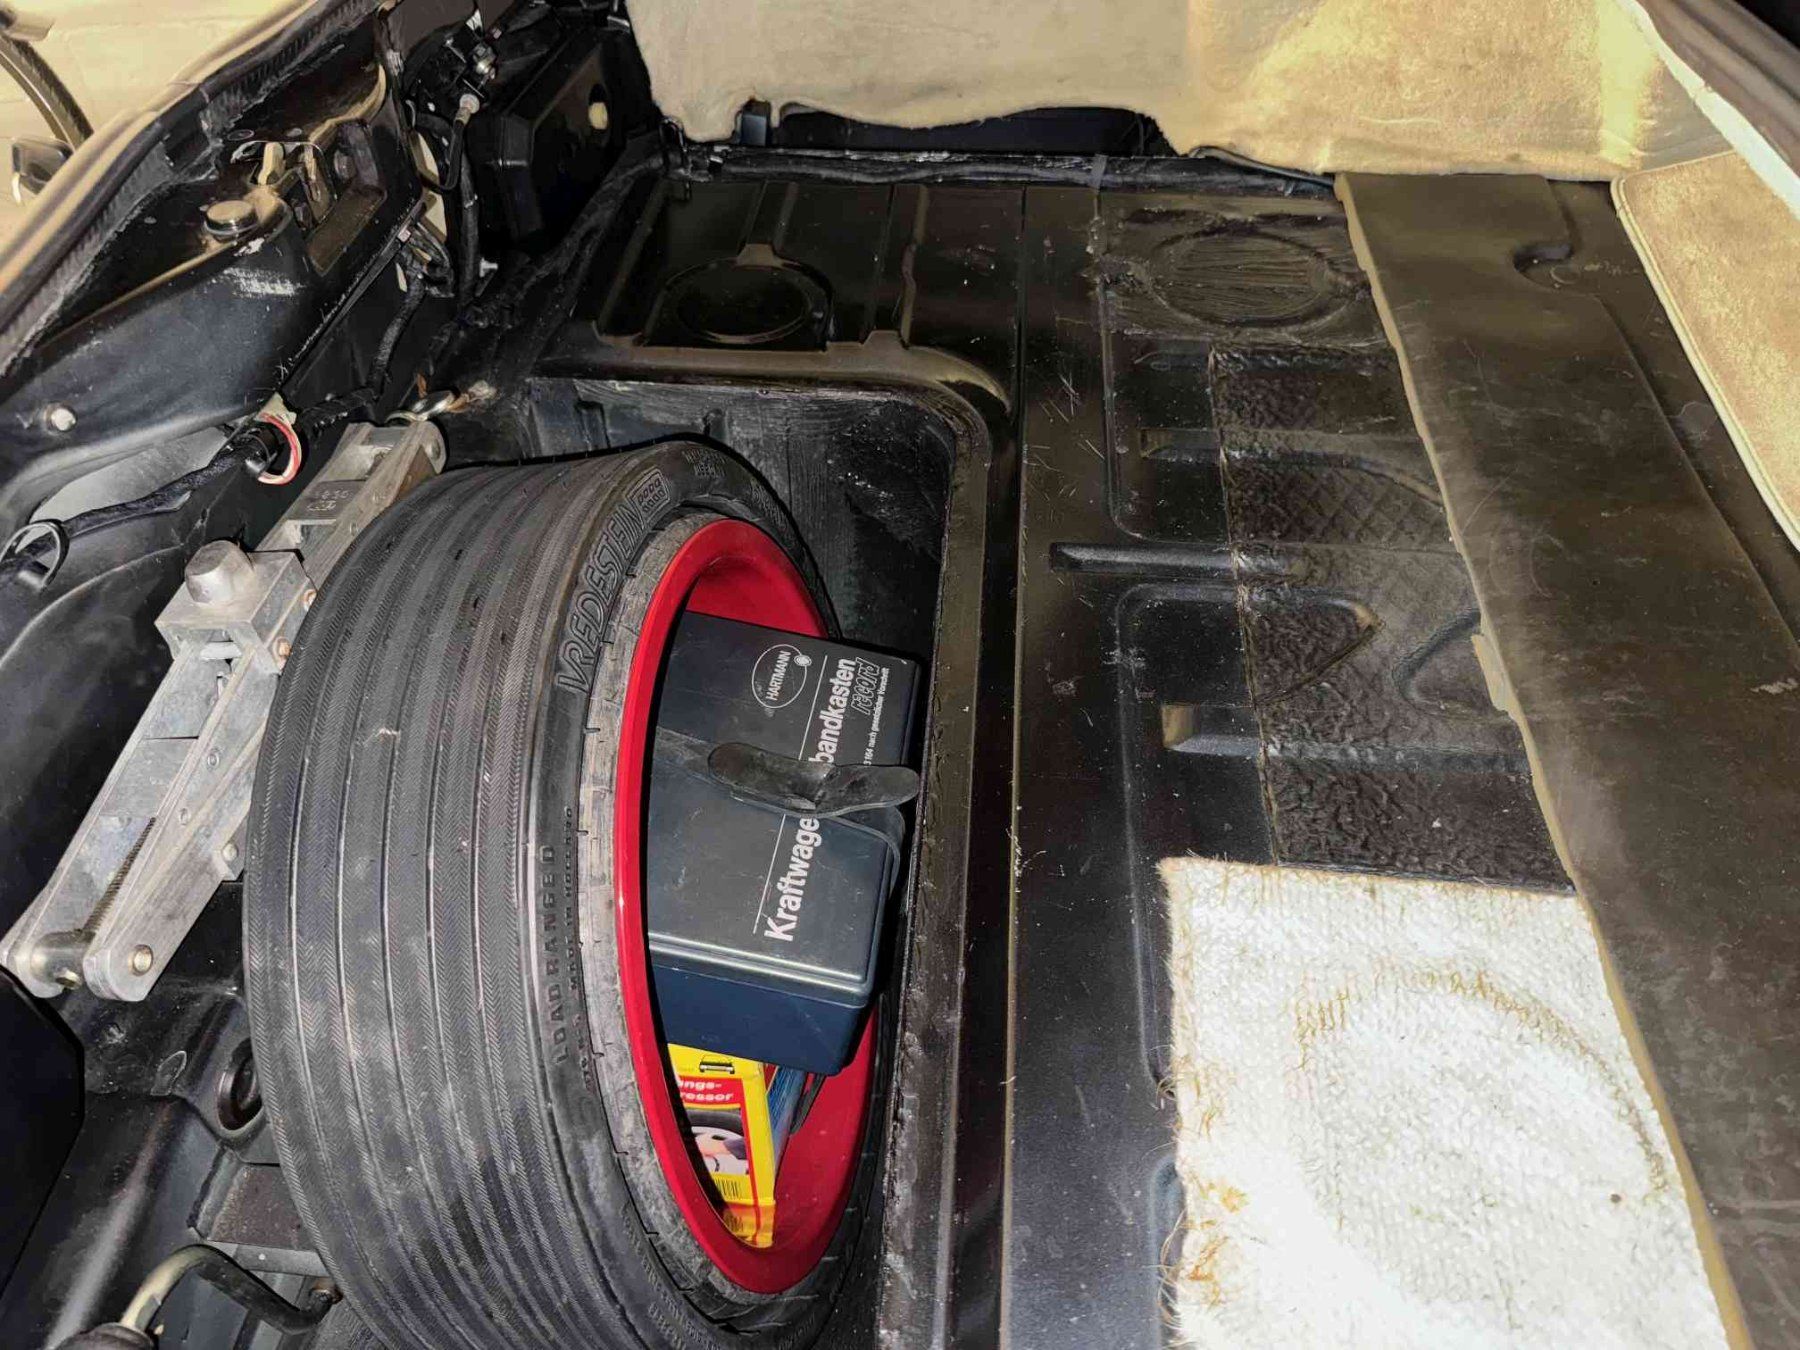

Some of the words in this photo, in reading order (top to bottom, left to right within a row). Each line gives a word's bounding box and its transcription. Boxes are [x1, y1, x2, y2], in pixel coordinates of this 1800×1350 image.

[556, 503, 645, 693] VREDESTEIN
[765, 650, 792, 701] HARTMANN
[808, 658, 857, 763] bandkasten
[850, 656, 881, 716] record
[542, 873, 560, 976] RANGE
[764, 818, 822, 941] Kraftwage
[547, 984, 569, 1064] LOAD
